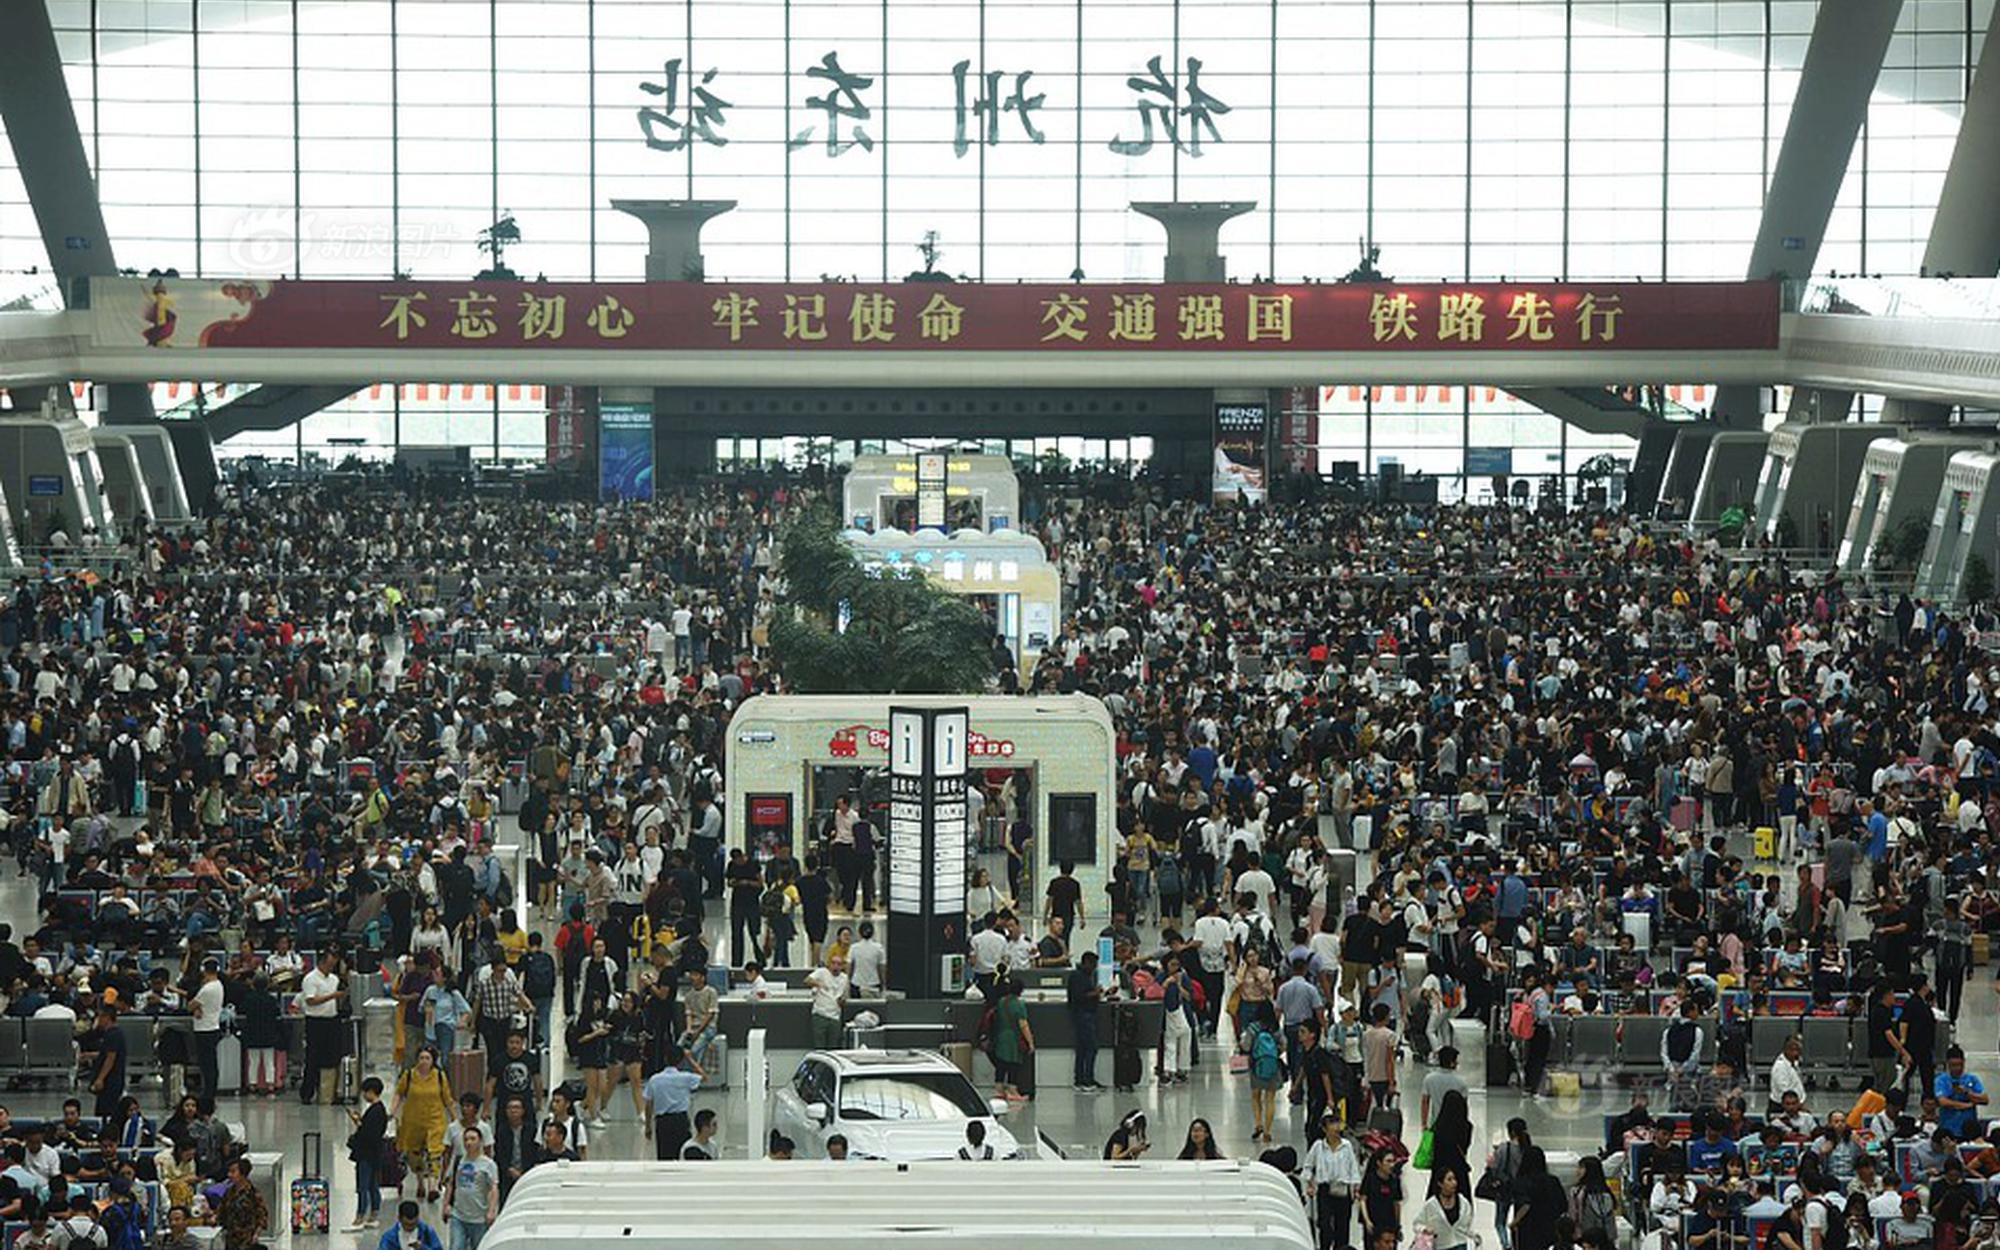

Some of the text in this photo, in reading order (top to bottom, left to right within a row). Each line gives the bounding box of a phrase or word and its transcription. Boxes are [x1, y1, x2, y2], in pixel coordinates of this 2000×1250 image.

[380, 291, 1625, 342] 不忘初心 牢记使命 交通强国 铁路先行
